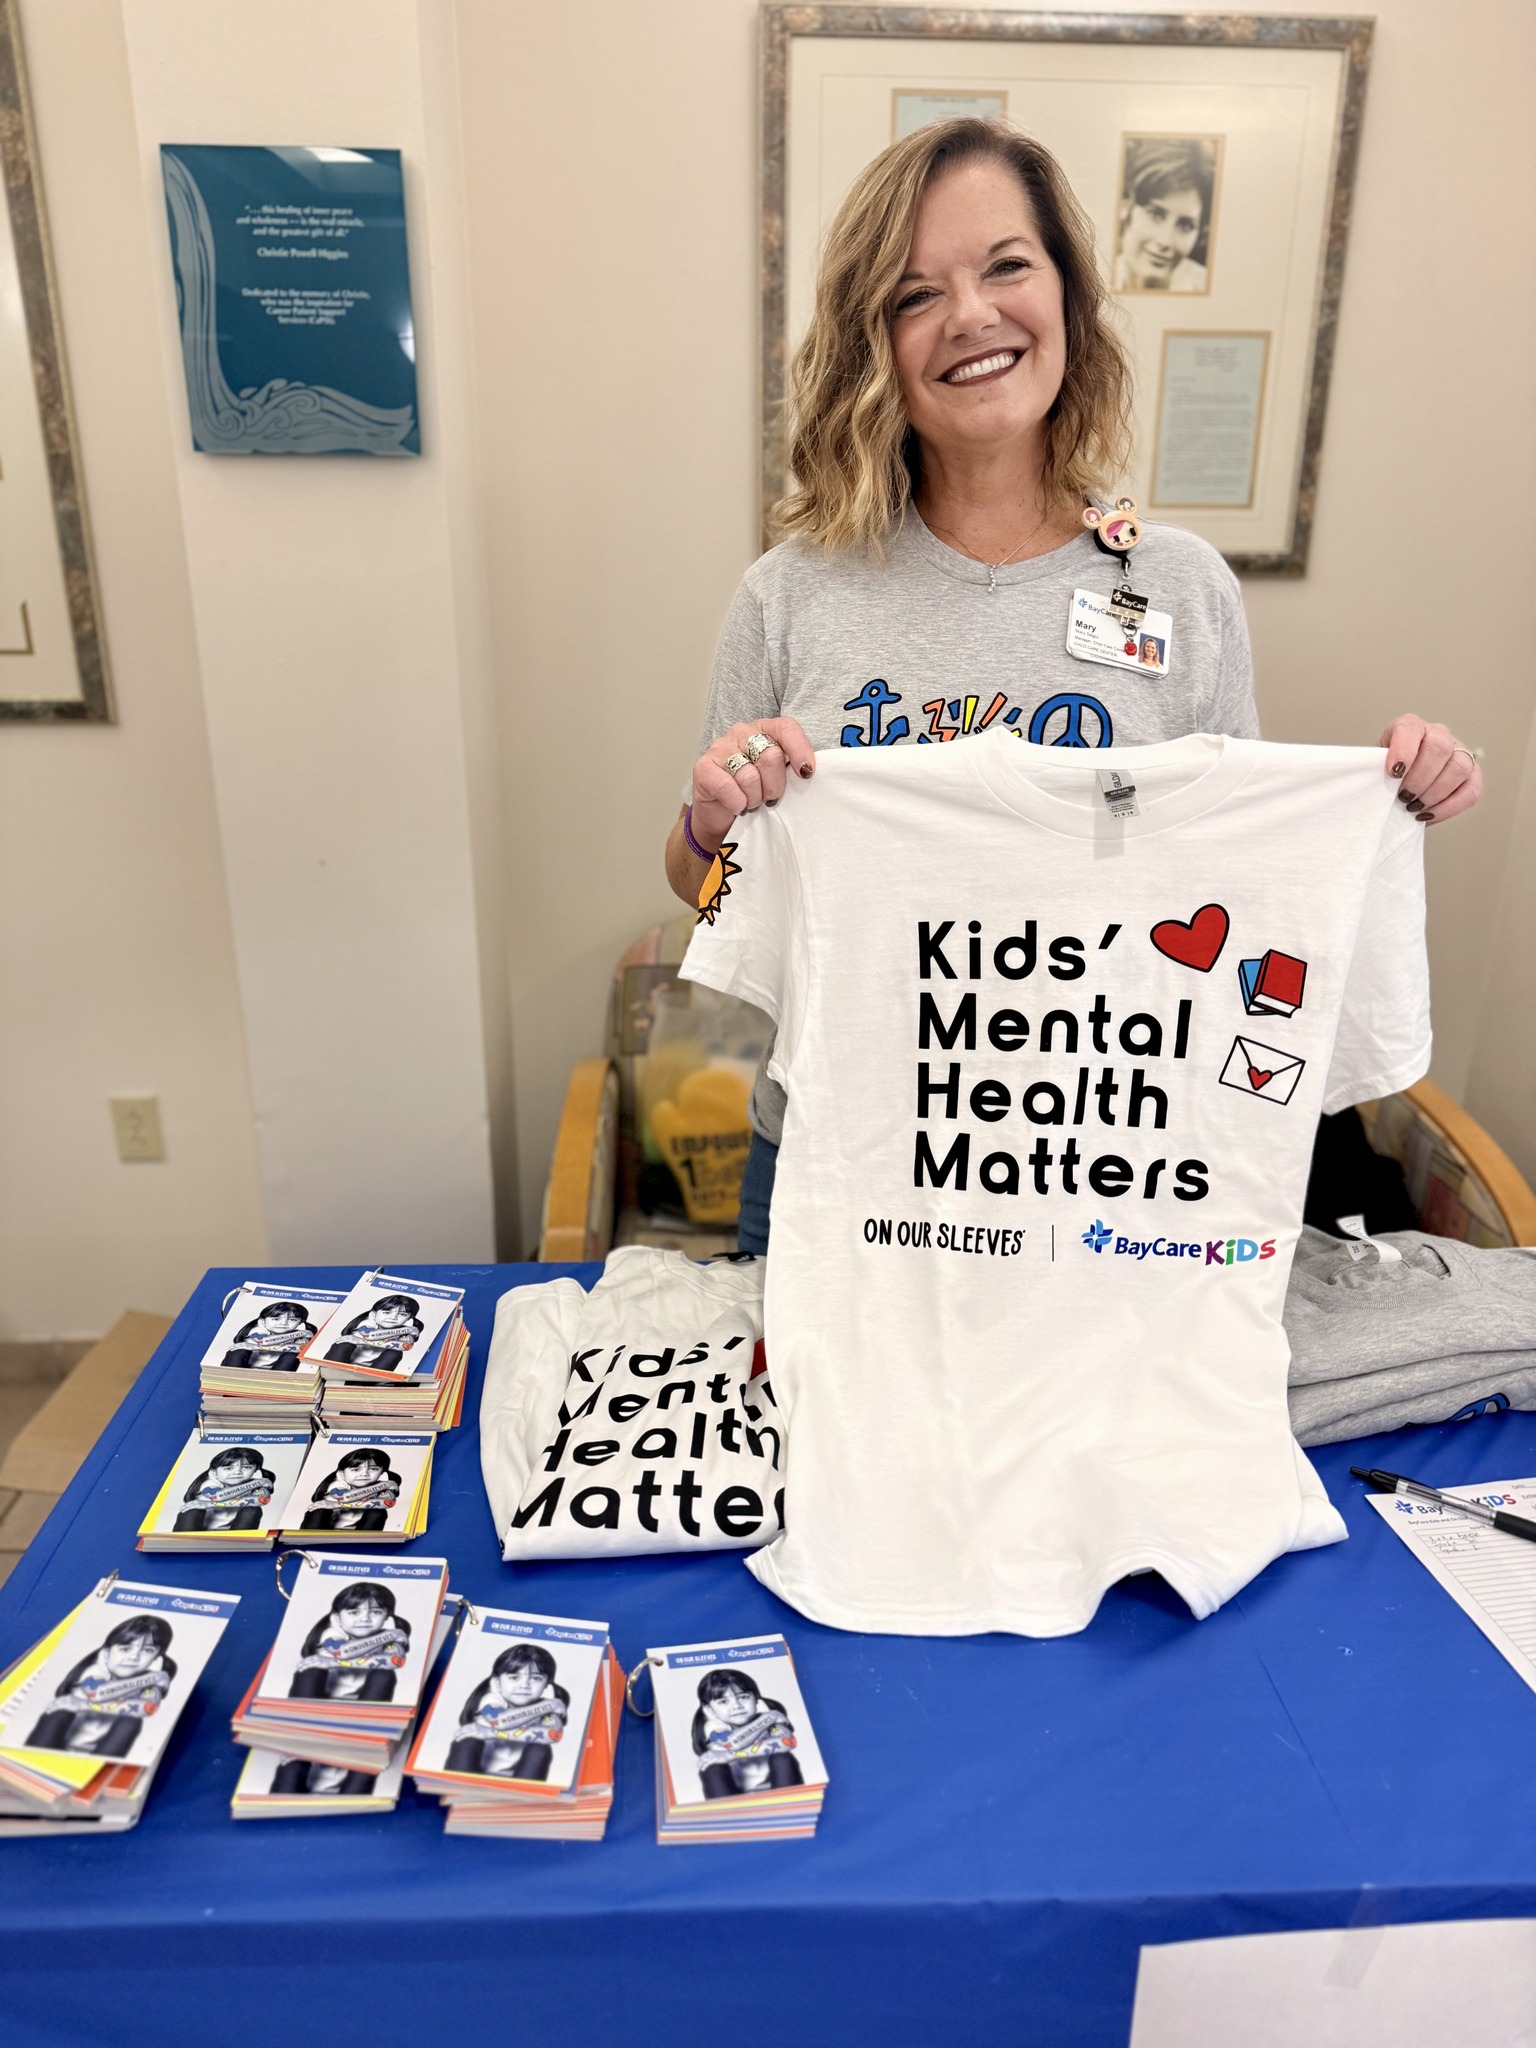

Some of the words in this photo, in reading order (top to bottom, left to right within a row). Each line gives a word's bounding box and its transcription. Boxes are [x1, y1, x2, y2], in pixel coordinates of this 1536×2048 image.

[241, 288, 279, 297] Dedicated
[279, 289, 287, 297] to
[288, 289, 300, 298] the
[1121, 598, 1147, 610] BayCare
[1088, 604, 1117, 618] BayCare
[1075, 620, 1097, 633] Mary
[918, 992, 1193, 1059] Mental
[917, 1062, 1168, 1129] Health
[913, 1131, 1209, 1202] Matters
[864, 1218, 892, 1245] ON
[897, 1221, 932, 1248] OUR
[937, 1222, 1025, 1256] SLEEVES
[1114, 1236, 1202, 1260] BayCare
[136, 1596, 160, 1604] SLEEVES
[511, 1625, 533, 1634] SLEEVES
[694, 1654, 716, 1662] SLEEVES
